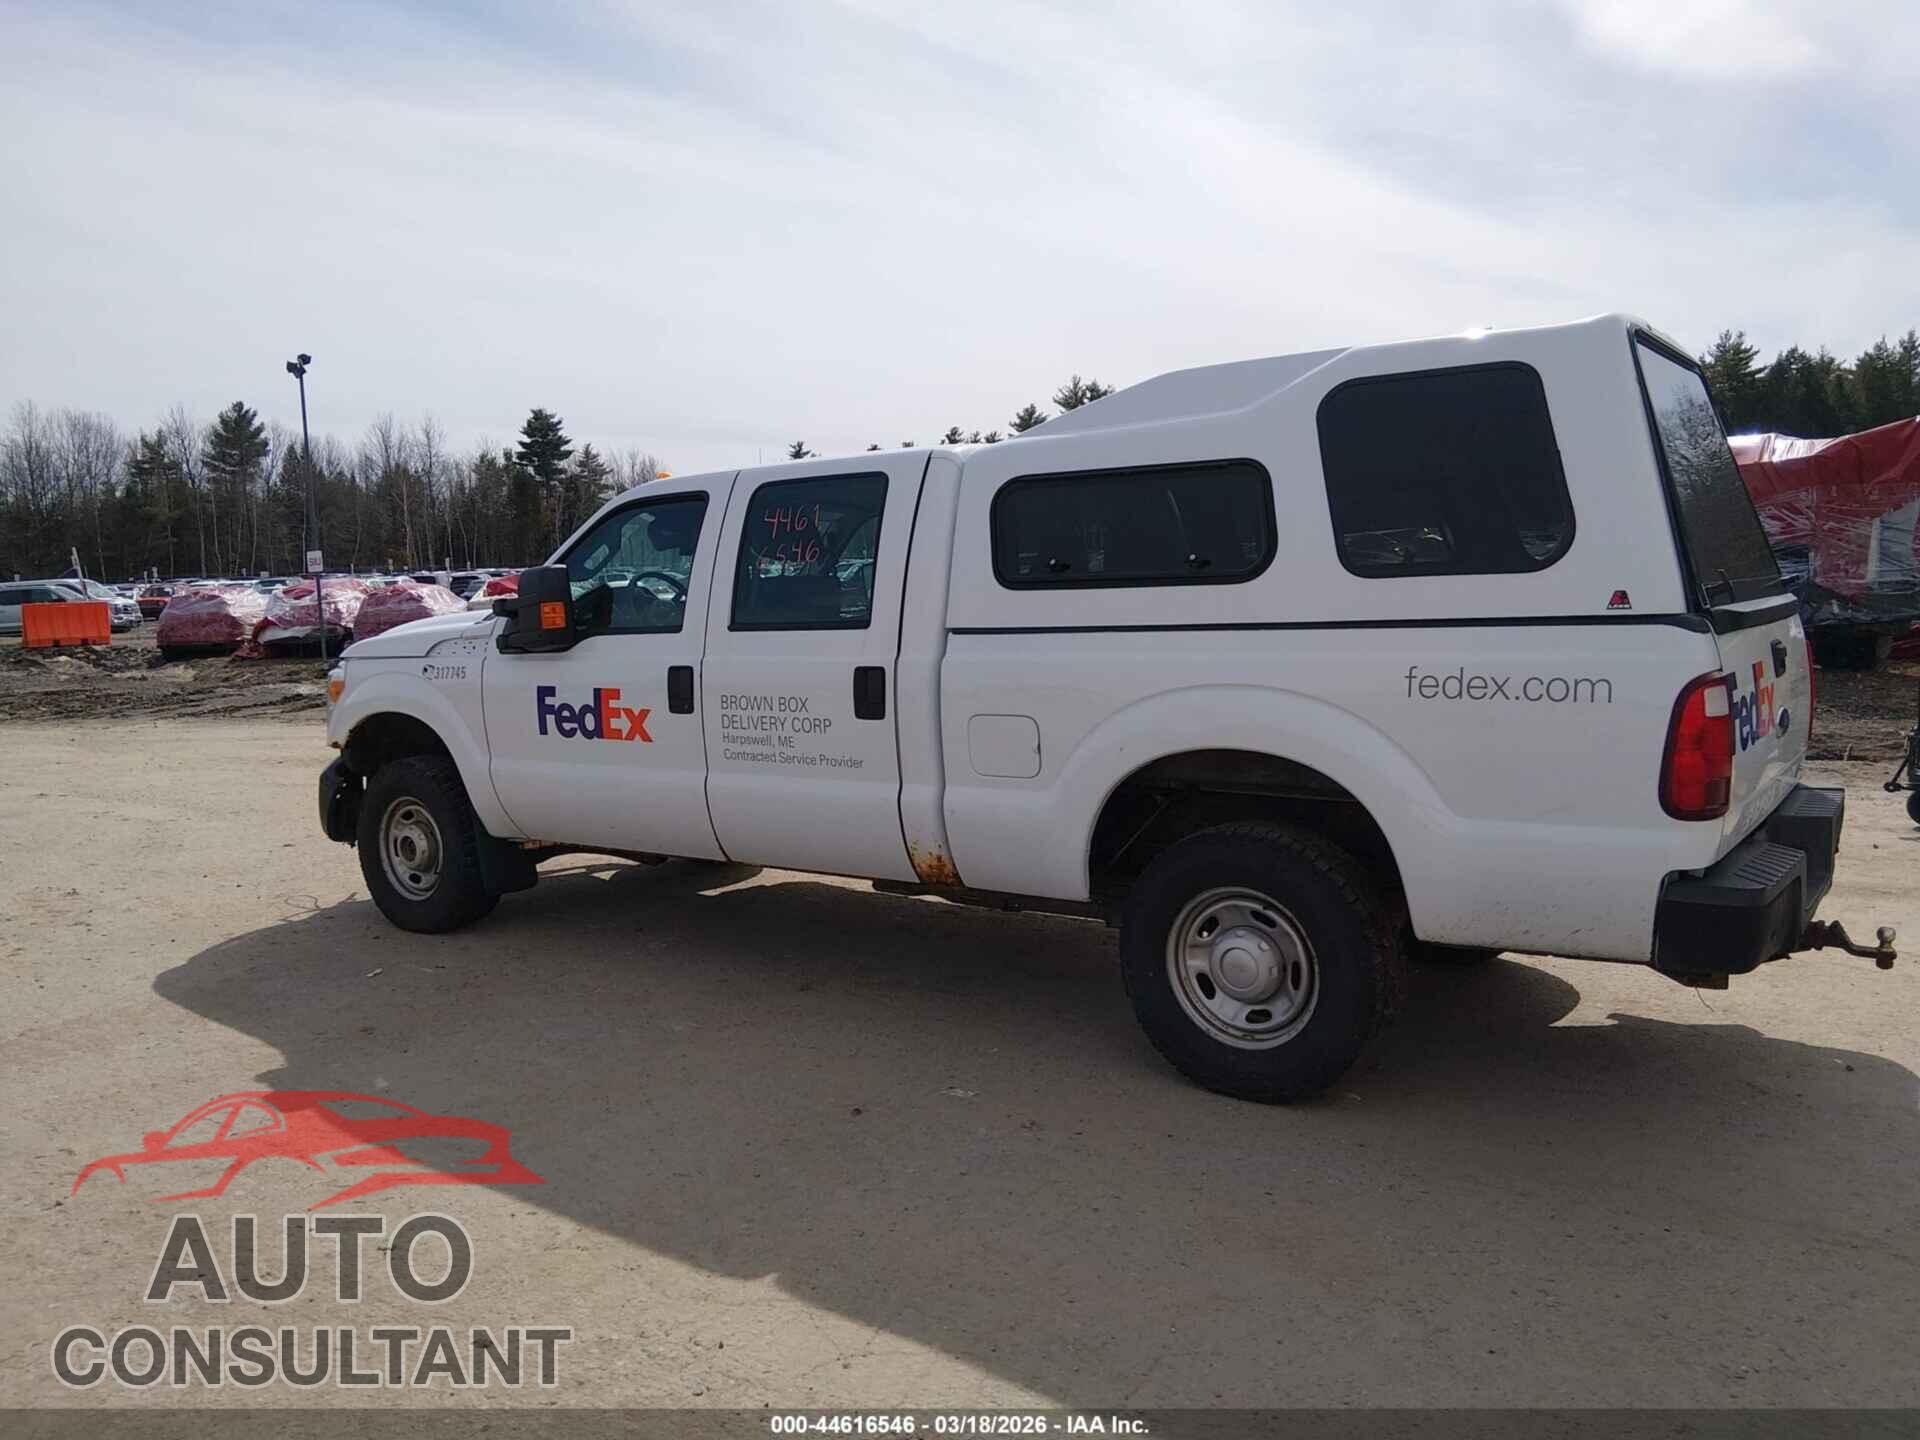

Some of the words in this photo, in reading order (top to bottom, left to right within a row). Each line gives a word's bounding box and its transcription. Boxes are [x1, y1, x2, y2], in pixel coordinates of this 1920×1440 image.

[764, 503, 820, 539] 4461
[1404, 665, 1613, 703] fedex.com
[536, 685, 653, 743] FedEx
[720, 694, 774, 711] BROWN
[778, 696, 809, 713] BOX
[721, 714, 787, 732] DELIVERY
[791, 717, 832, 735] CORP
[722, 732, 776, 748] Harpswell,
[778, 735, 795, 748] ME
[723, 748, 777, 763] Contracted
[779, 751, 817, 766] Service
[819, 753, 864, 769] Provider
